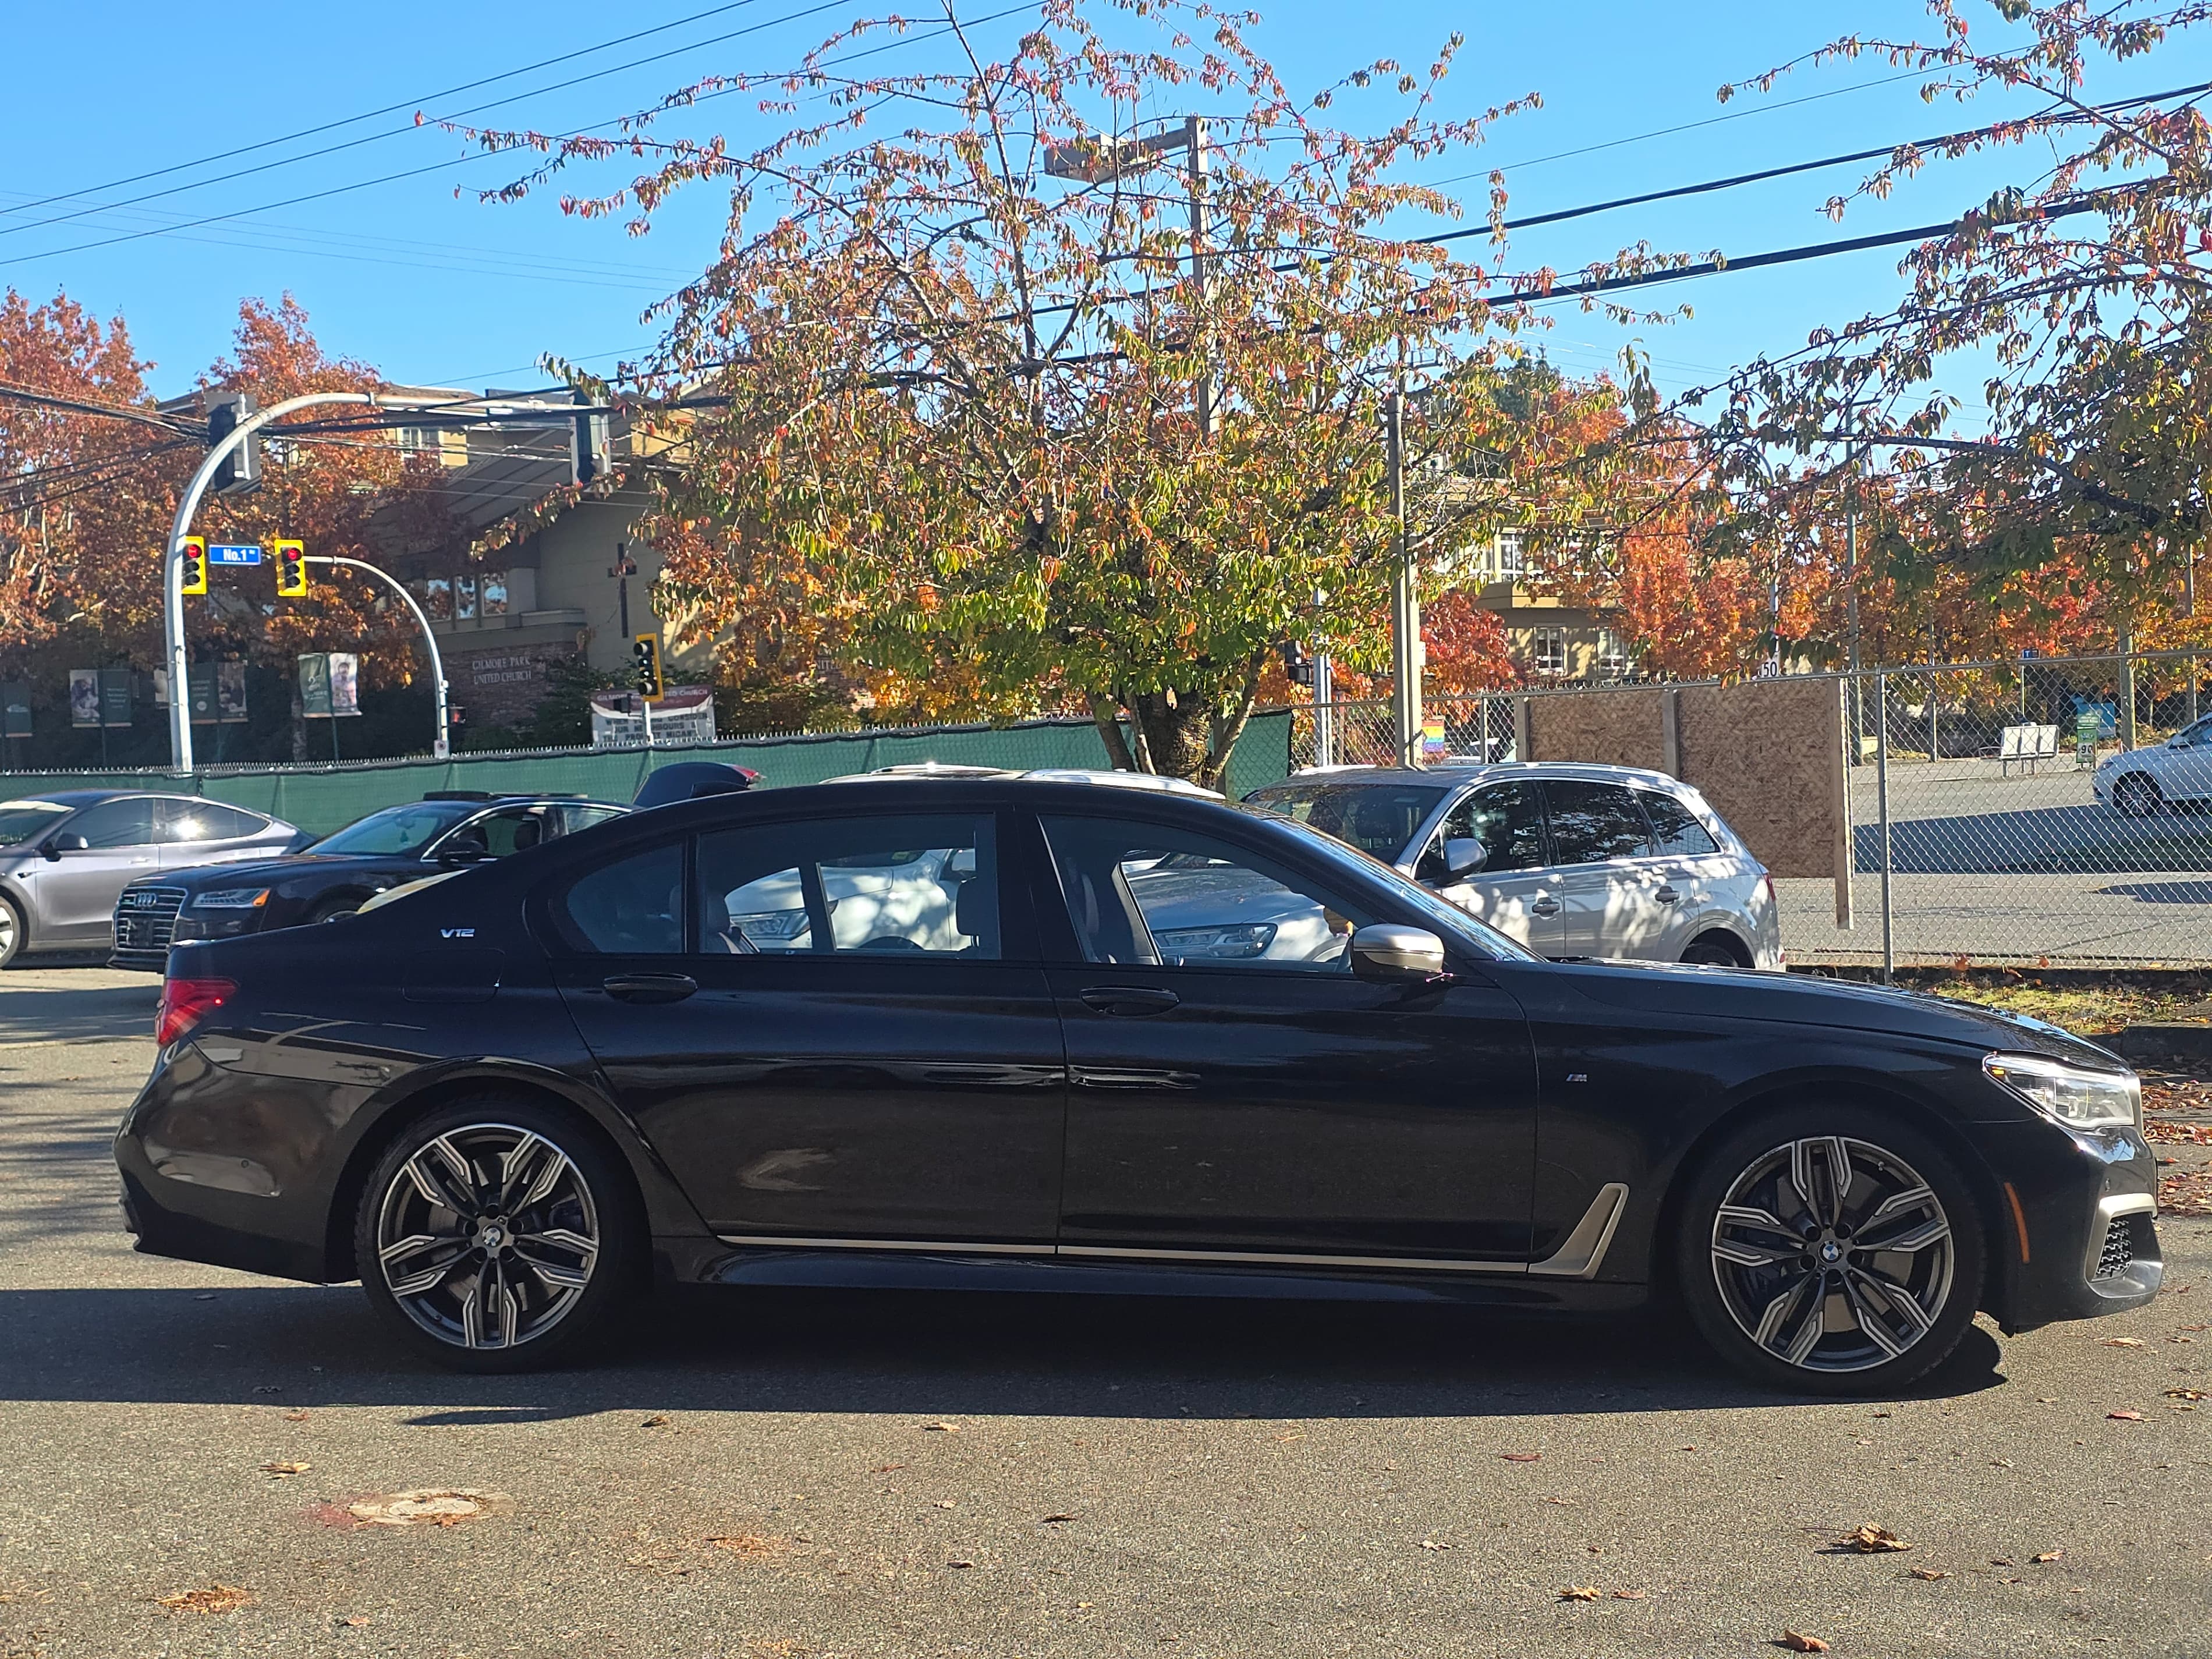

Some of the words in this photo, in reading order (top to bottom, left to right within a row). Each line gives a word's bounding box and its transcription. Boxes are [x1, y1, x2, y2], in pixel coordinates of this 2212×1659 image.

[223, 548, 247, 561] No.1
[472, 658, 508, 671] GILMORE
[509, 656, 531, 667] PARK
[1764, 661, 1777, 676] 50
[473, 672, 501, 685] UNITED
[501, 670, 531, 682] CHURCH
[679, 689, 708, 697] CHURCH
[441, 928, 475, 938] V12
